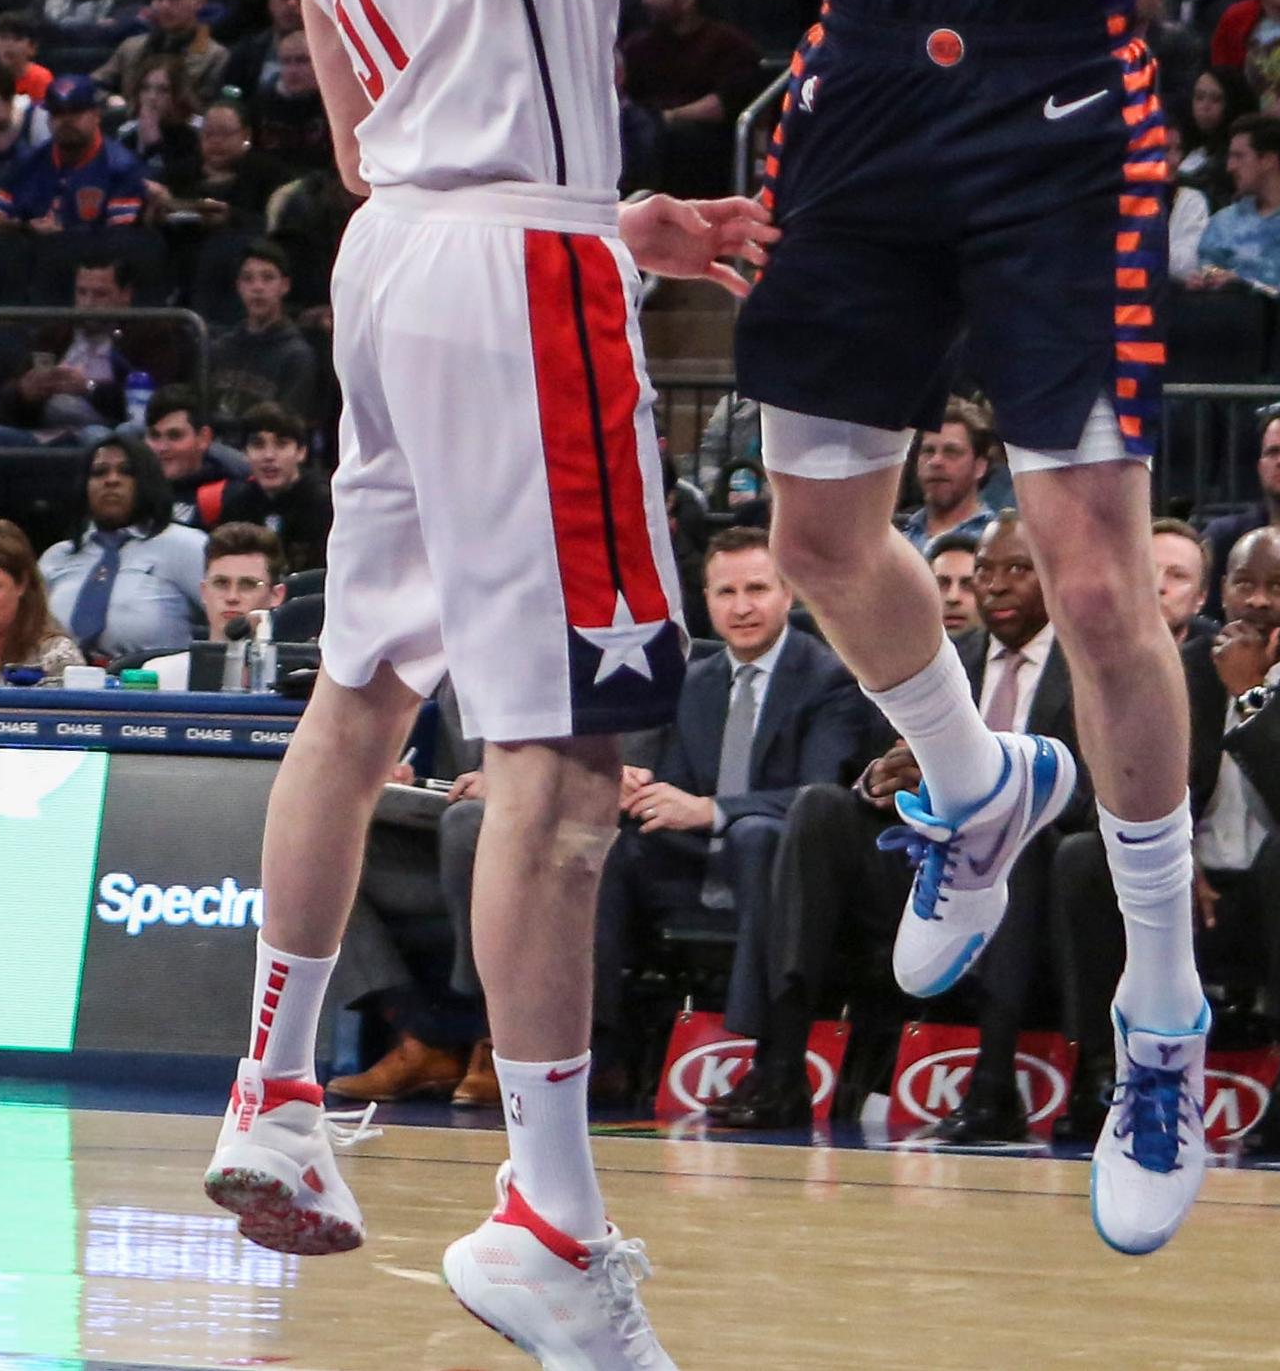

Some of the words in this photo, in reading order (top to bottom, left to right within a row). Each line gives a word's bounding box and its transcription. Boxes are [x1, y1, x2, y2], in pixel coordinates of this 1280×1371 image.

[57, 723, 101, 736] CHASE
[121, 725, 166, 738] CHASE
[186, 728, 232, 741] CHASE
